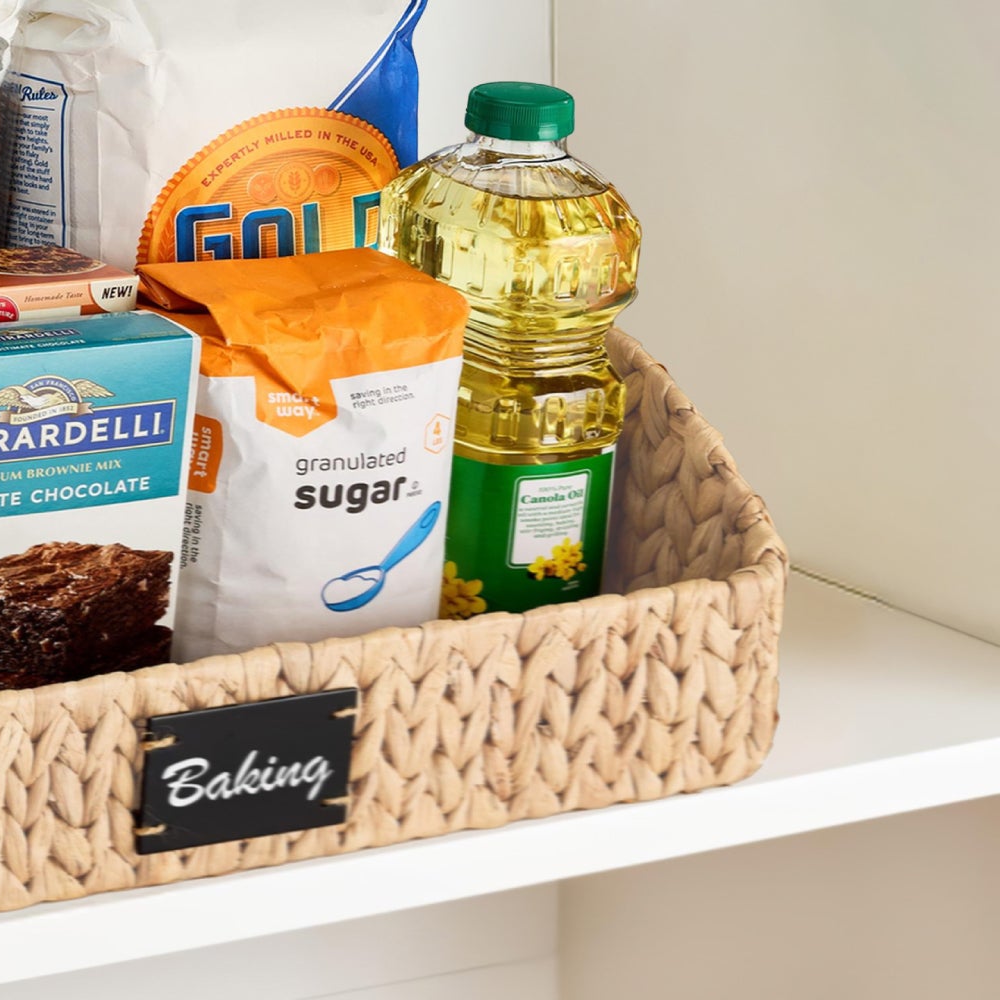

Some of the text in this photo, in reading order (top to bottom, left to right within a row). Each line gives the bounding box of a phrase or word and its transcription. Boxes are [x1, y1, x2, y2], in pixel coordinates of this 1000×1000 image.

[21, 85, 59, 102] Rules
[201, 129, 379, 188] EXPERTLY MILLED IN THE USA
[24, 291, 84, 304] Homemade Taste
[101, 285, 133, 300] NEW!
[37, 339, 86, 349] CHOCOLATE
[45, 380, 77, 402] FRANCISCO
[268, 392, 320, 406] smat
[350, 384, 408, 401] saving in the
[276, 405, 315, 420] way
[352, 397, 376, 409] right
[14, 410, 48, 422] FOUNDED
[193, 426, 212, 479] smart
[295, 447, 407, 476] granulated
[26, 462, 93, 480] BROWNIE
[95, 459, 122, 471] MIX
[30, 476, 150, 504] CHOCOLATE
[294, 476, 407, 514] sugar
[520, 488, 584, 504] Canola Oil
[184, 502, 194, 525] right
[190, 504, 203, 563] saving in the
[161, 750, 335, 808] Baking
